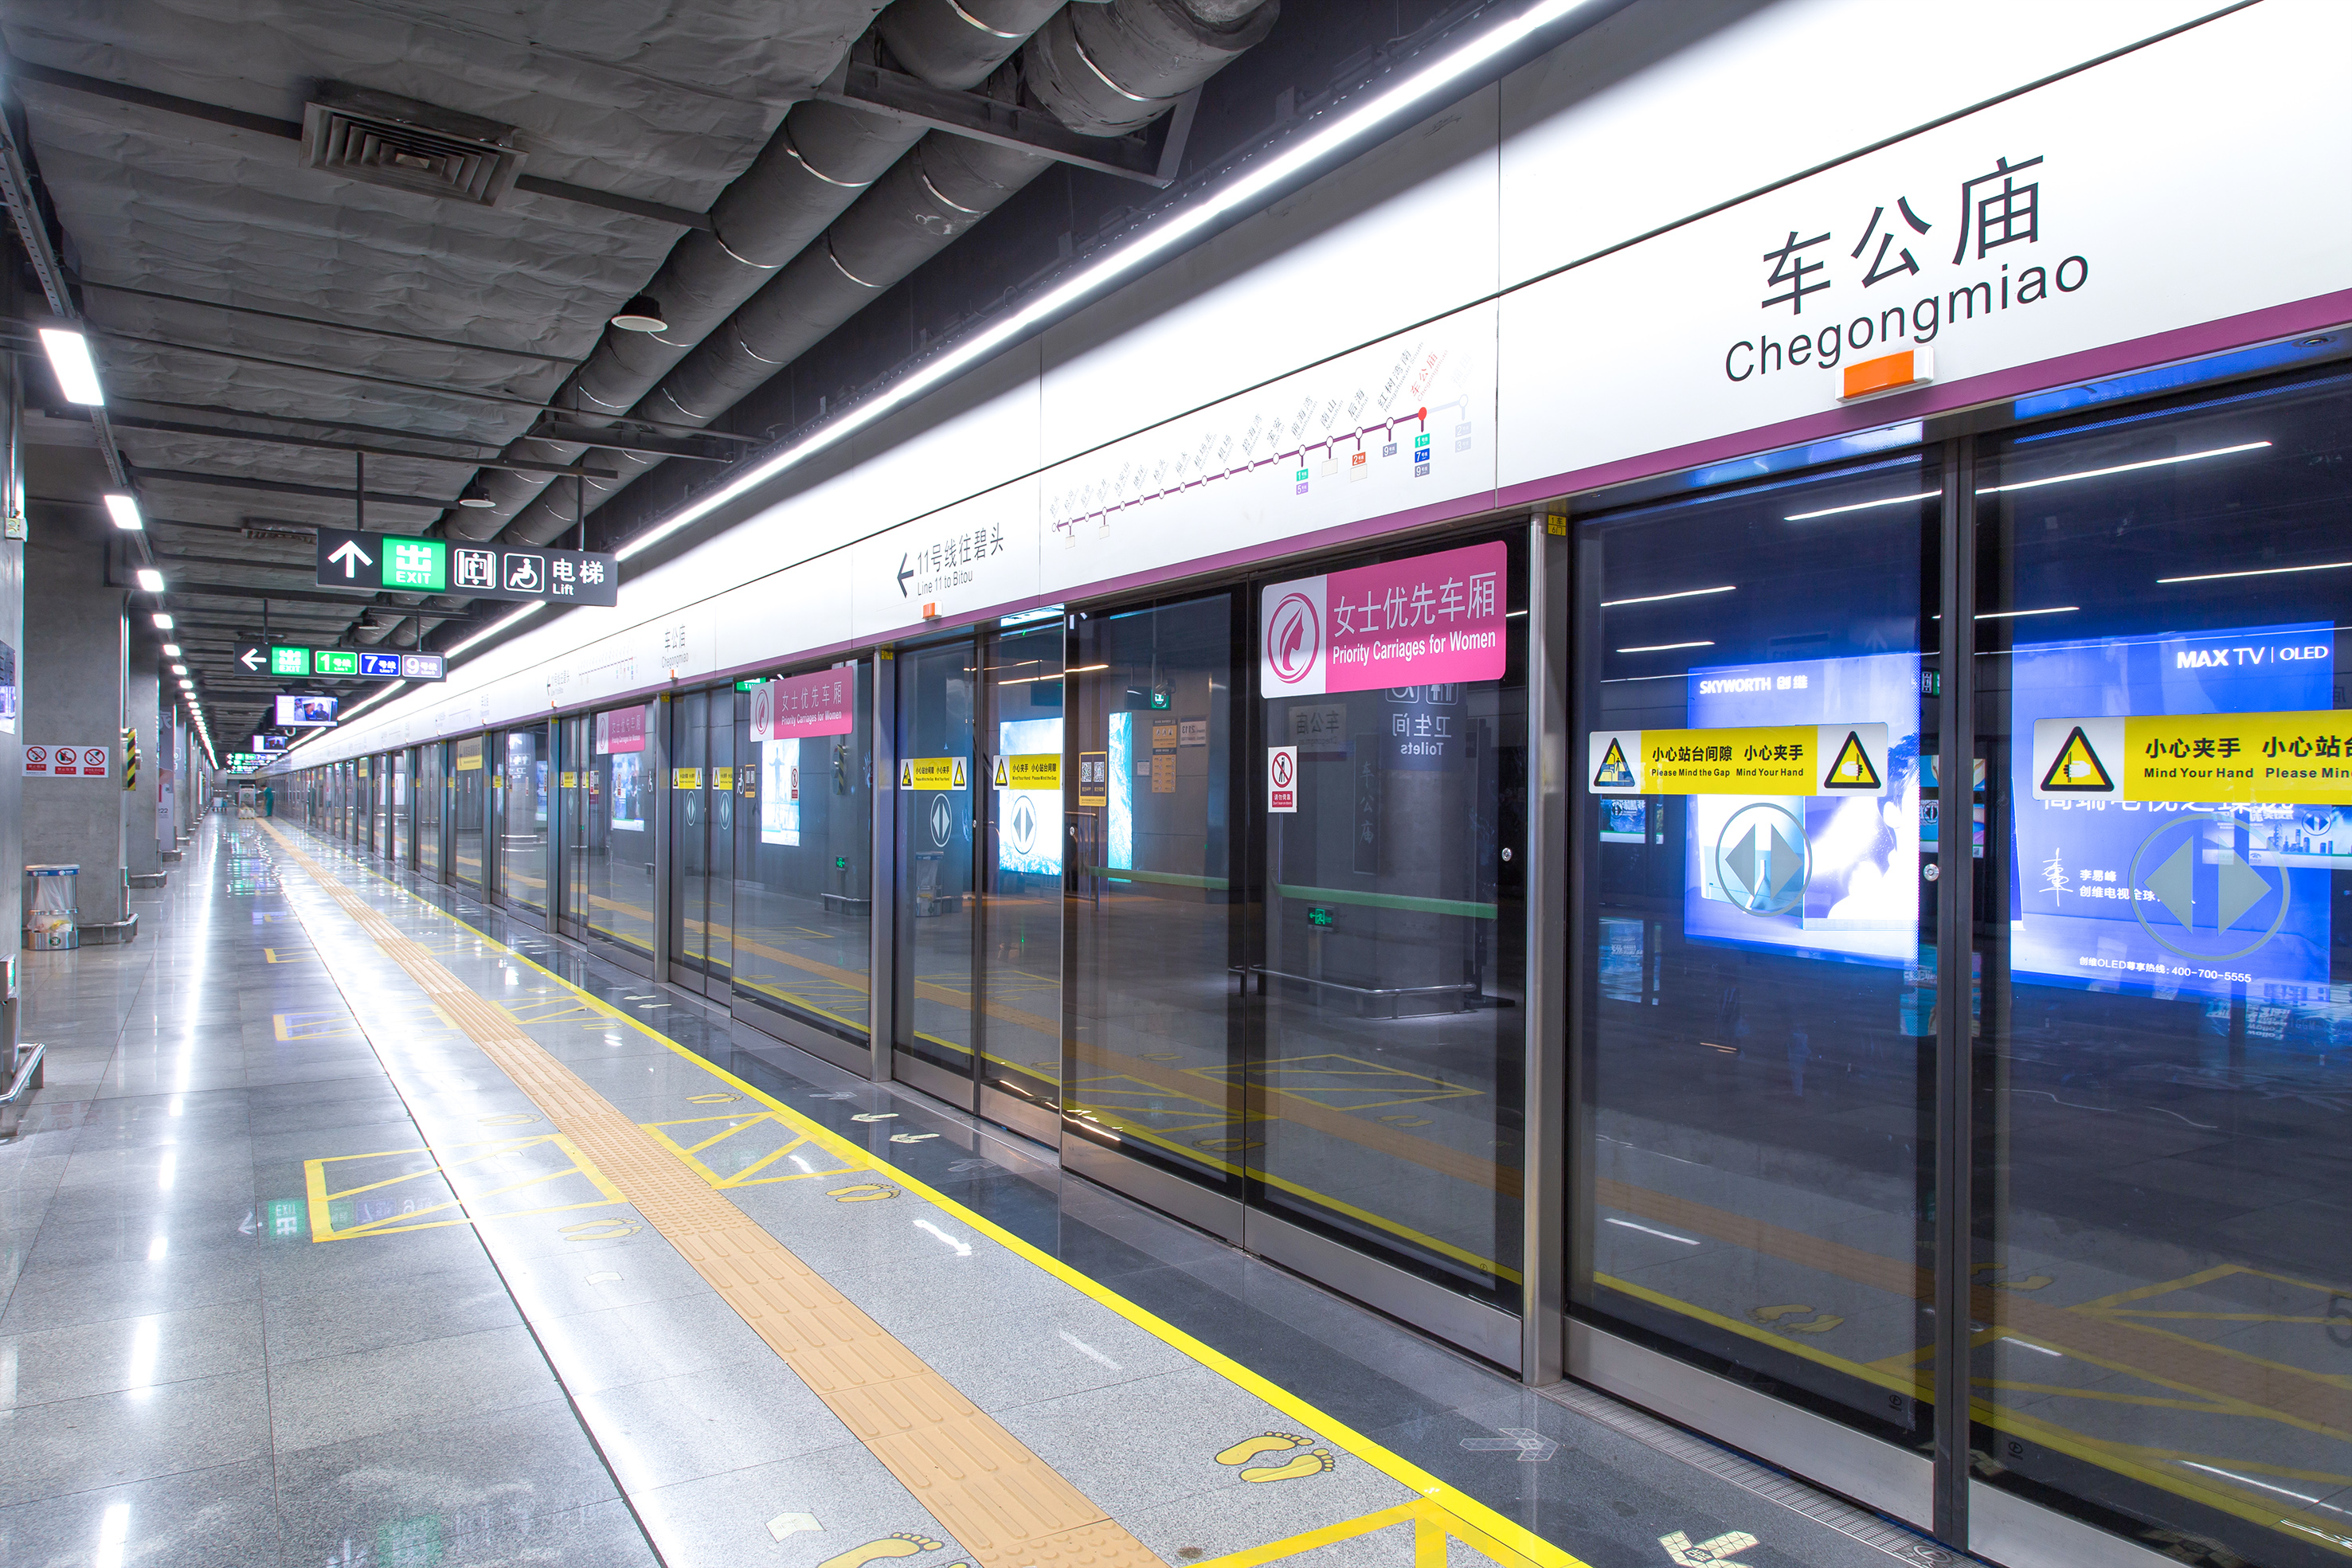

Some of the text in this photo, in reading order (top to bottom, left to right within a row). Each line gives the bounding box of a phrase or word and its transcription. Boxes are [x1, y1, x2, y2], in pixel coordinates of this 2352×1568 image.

[1761, 154, 2044, 315] 车公庙
[1724, 255, 2088, 383] Chegongmiao
[1410, 351, 1438, 397] 车公庙
[1417, 350, 1448, 402] Chegongmiao
[1320, 399, 1337, 427] 南山
[918, 522, 1004, 574] 11号线往碧头
[396, 571, 431, 585] EXIT
[552, 557, 605, 585] 电梯
[552, 583, 574, 596] Lift
[918, 570, 973, 596] Line 11 to Bitou
[1333, 571, 1497, 638] 女士优先车厢
[1333, 630, 1496, 667] Priority Carriages for Women
[2177, 646, 2328, 668] MAX TV OLED
[1699, 677, 1771, 694] SKYWORTH
[1776, 675, 1808, 690] 创维
[781, 680, 843, 712] 女士优先车厢
[781, 715, 796, 727] Priority
[796, 713, 816, 725] Carriages
[825, 710, 842, 721] Women
[1652, 744, 1803, 762] 小心站台间隙 小心夹手
[2144, 737, 2241, 759] 小心夹手
[1012, 764, 1028, 772] 小心夹手
[1651, 768, 1677, 777] Please
[1678, 768, 1697, 777] Mind
[1699, 768, 1712, 777] the
[1713, 768, 1731, 779] Gap
[1780, 768, 1803, 776] Hand
[2144, 767, 2352, 778] Mind Your Hand Please Min
[2080, 869, 2117, 882] 李易峰
[2080, 886, 2161, 902] 创维电视全球
